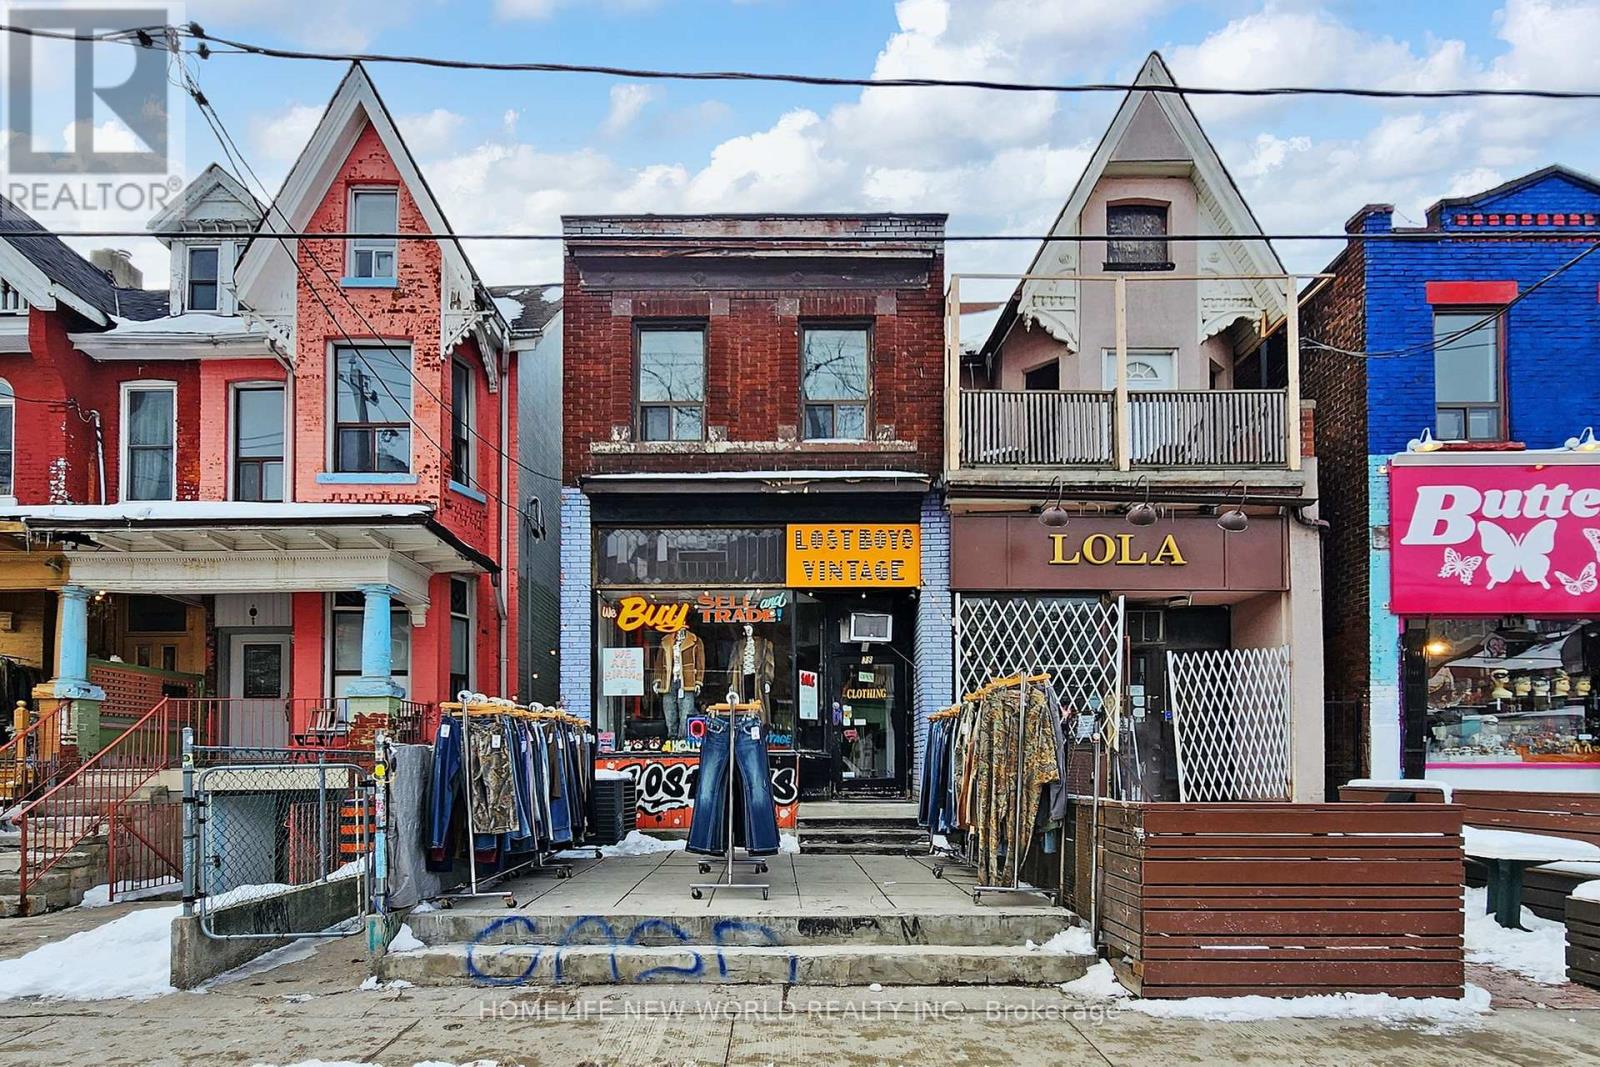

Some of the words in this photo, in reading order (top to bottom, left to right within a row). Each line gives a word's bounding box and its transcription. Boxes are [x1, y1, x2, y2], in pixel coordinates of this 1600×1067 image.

[795, 529, 854, 550] LOST
[859, 529, 913, 550] BOYS
[1049, 533, 1187, 565] LOLA
[803, 560, 904, 580] VINTAGE
[760, 592, 787, 609] and
[602, 606, 617, 618] We
[617, 596, 689, 632] Buy
[698, 609, 784, 623] TRADE!
[847, 688, 887, 699] CLOTHING
